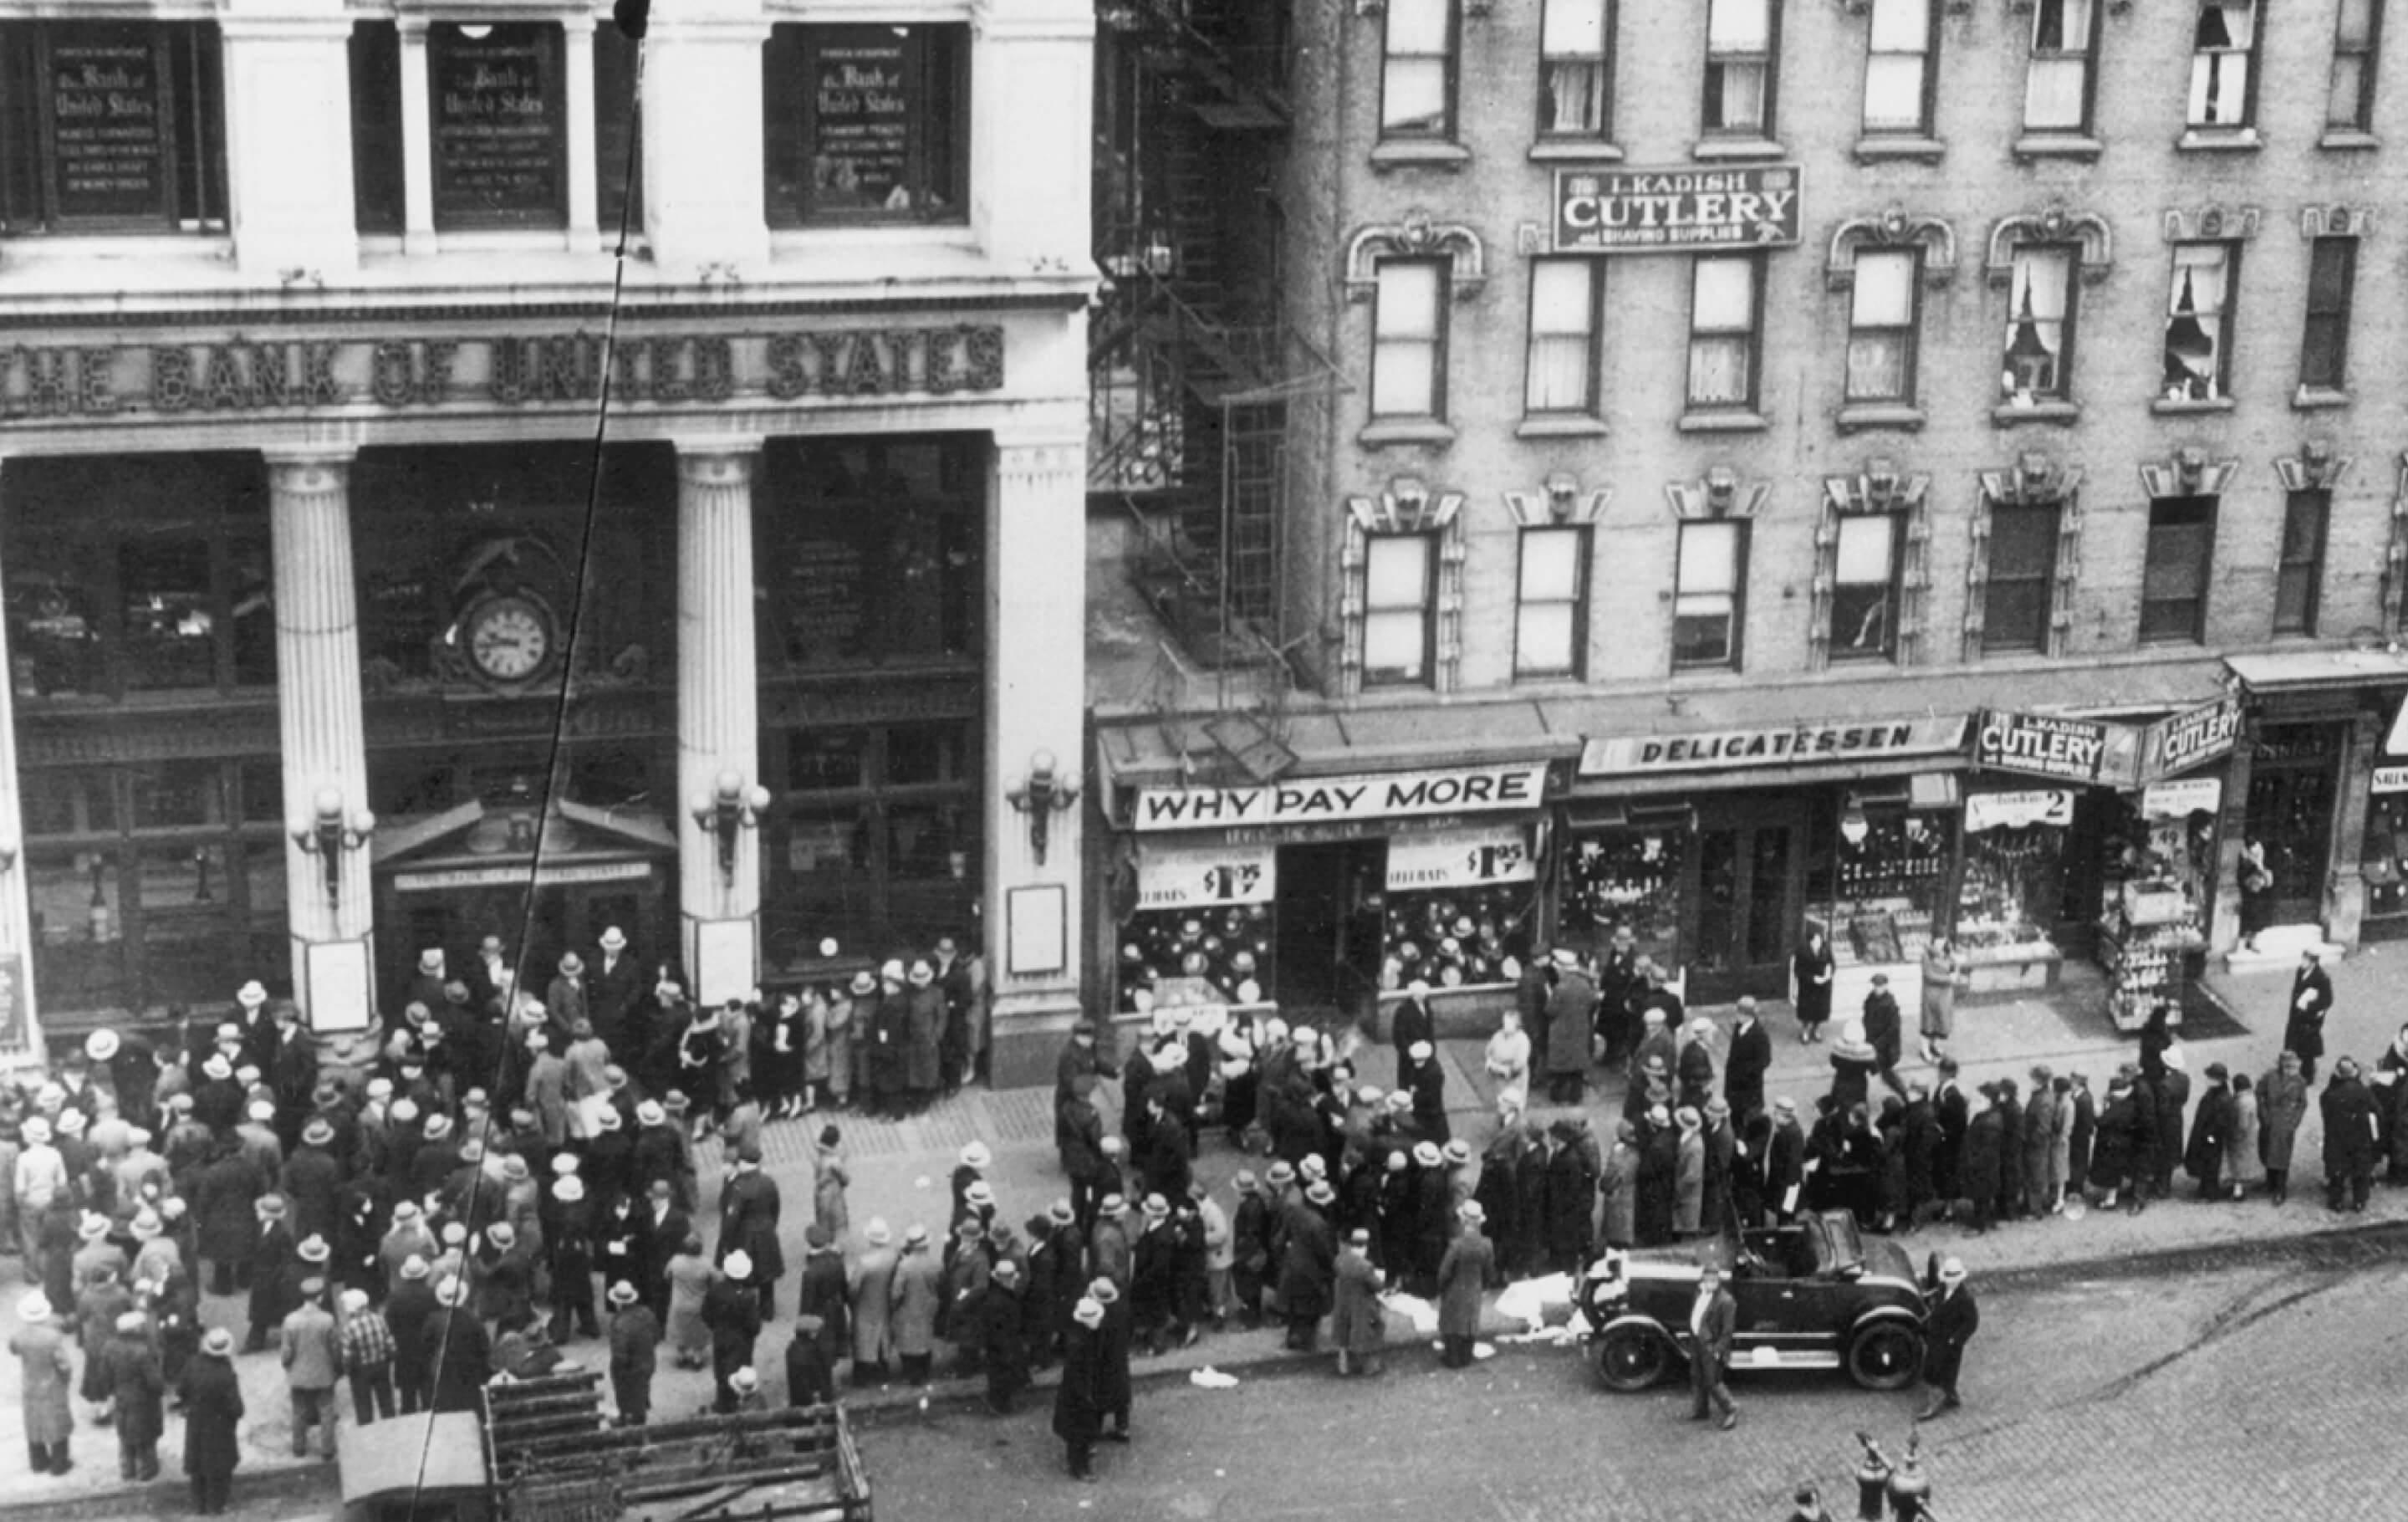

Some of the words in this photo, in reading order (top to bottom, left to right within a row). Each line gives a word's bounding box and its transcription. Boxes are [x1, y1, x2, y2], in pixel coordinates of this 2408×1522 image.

[1633, 171, 1746, 193] KADISH
[1564, 189, 1795, 227] CUTLERY
[151, 341, 339, 410] BANK
[373, 338, 458, 406] OF
[489, 335, 732, 403] UNITED
[766, 325, 1004, 400] STATES
[1641, 723, 1911, 763] DELICATESSEN
[1982, 725, 2102, 763] CUTLERY
[2166, 708, 2242, 758] CUTLERY
[1149, 791, 1259, 820] WHY
[1275, 785, 1368, 815] PAY
[1385, 771, 1532, 809] MORE
